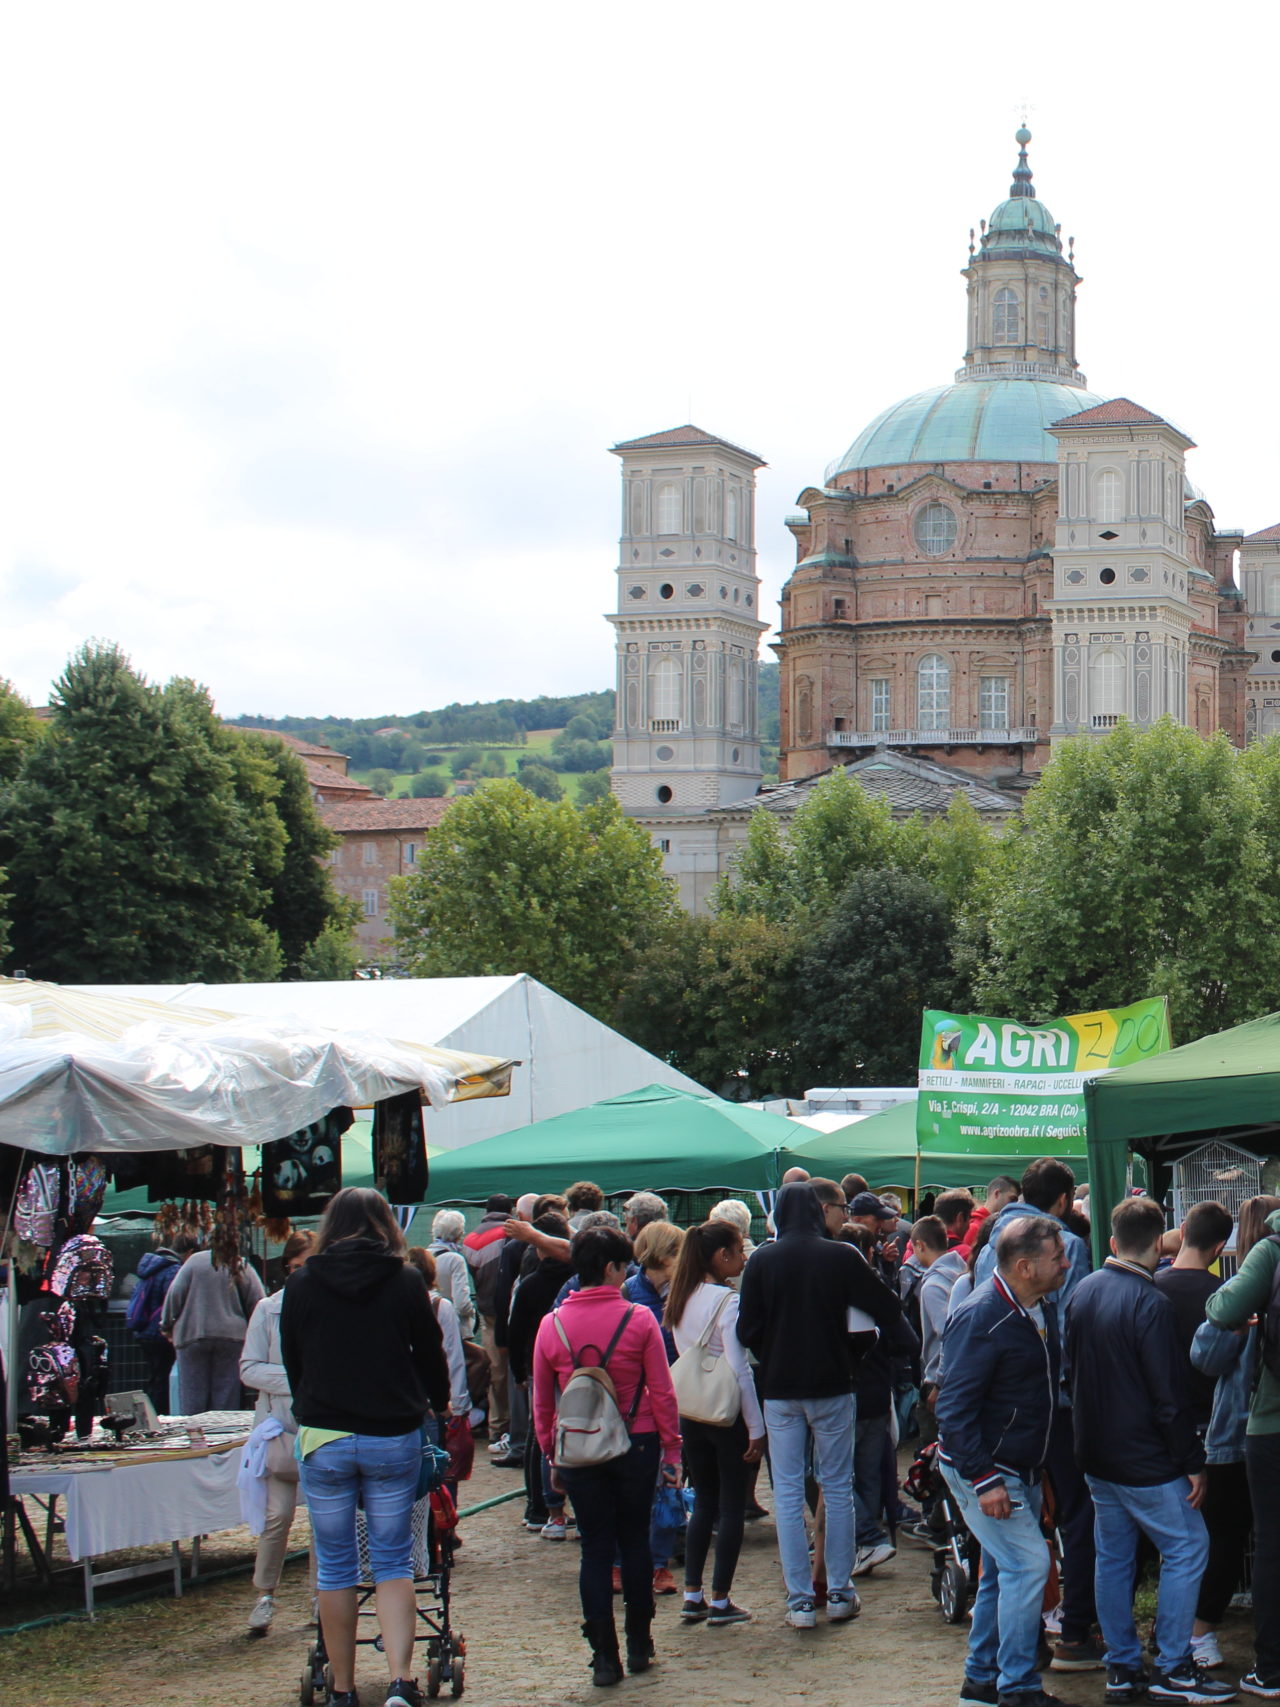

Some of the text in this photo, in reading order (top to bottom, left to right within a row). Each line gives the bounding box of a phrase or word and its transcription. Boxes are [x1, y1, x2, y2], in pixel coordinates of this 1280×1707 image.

[964, 1014, 1160, 1067] AGRI ZOO
[926, 1075, 1083, 1090] RETTILI MAMMIFERI RAPACI UCCELLI
[928, 1099, 942, 1112] Via
[951, 1100, 979, 1116] Crispi,
[981, 1103, 1000, 1115] 2/A
[1009, 1104, 1039, 1116] 12042
[1039, 1104, 1059, 1117] BRA
[1060, 1104, 1079, 1118] (Cn)
[960, 1124, 1040, 1139] www.agrizoobra.it
[1046, 1124, 1081, 1140] Seguici
